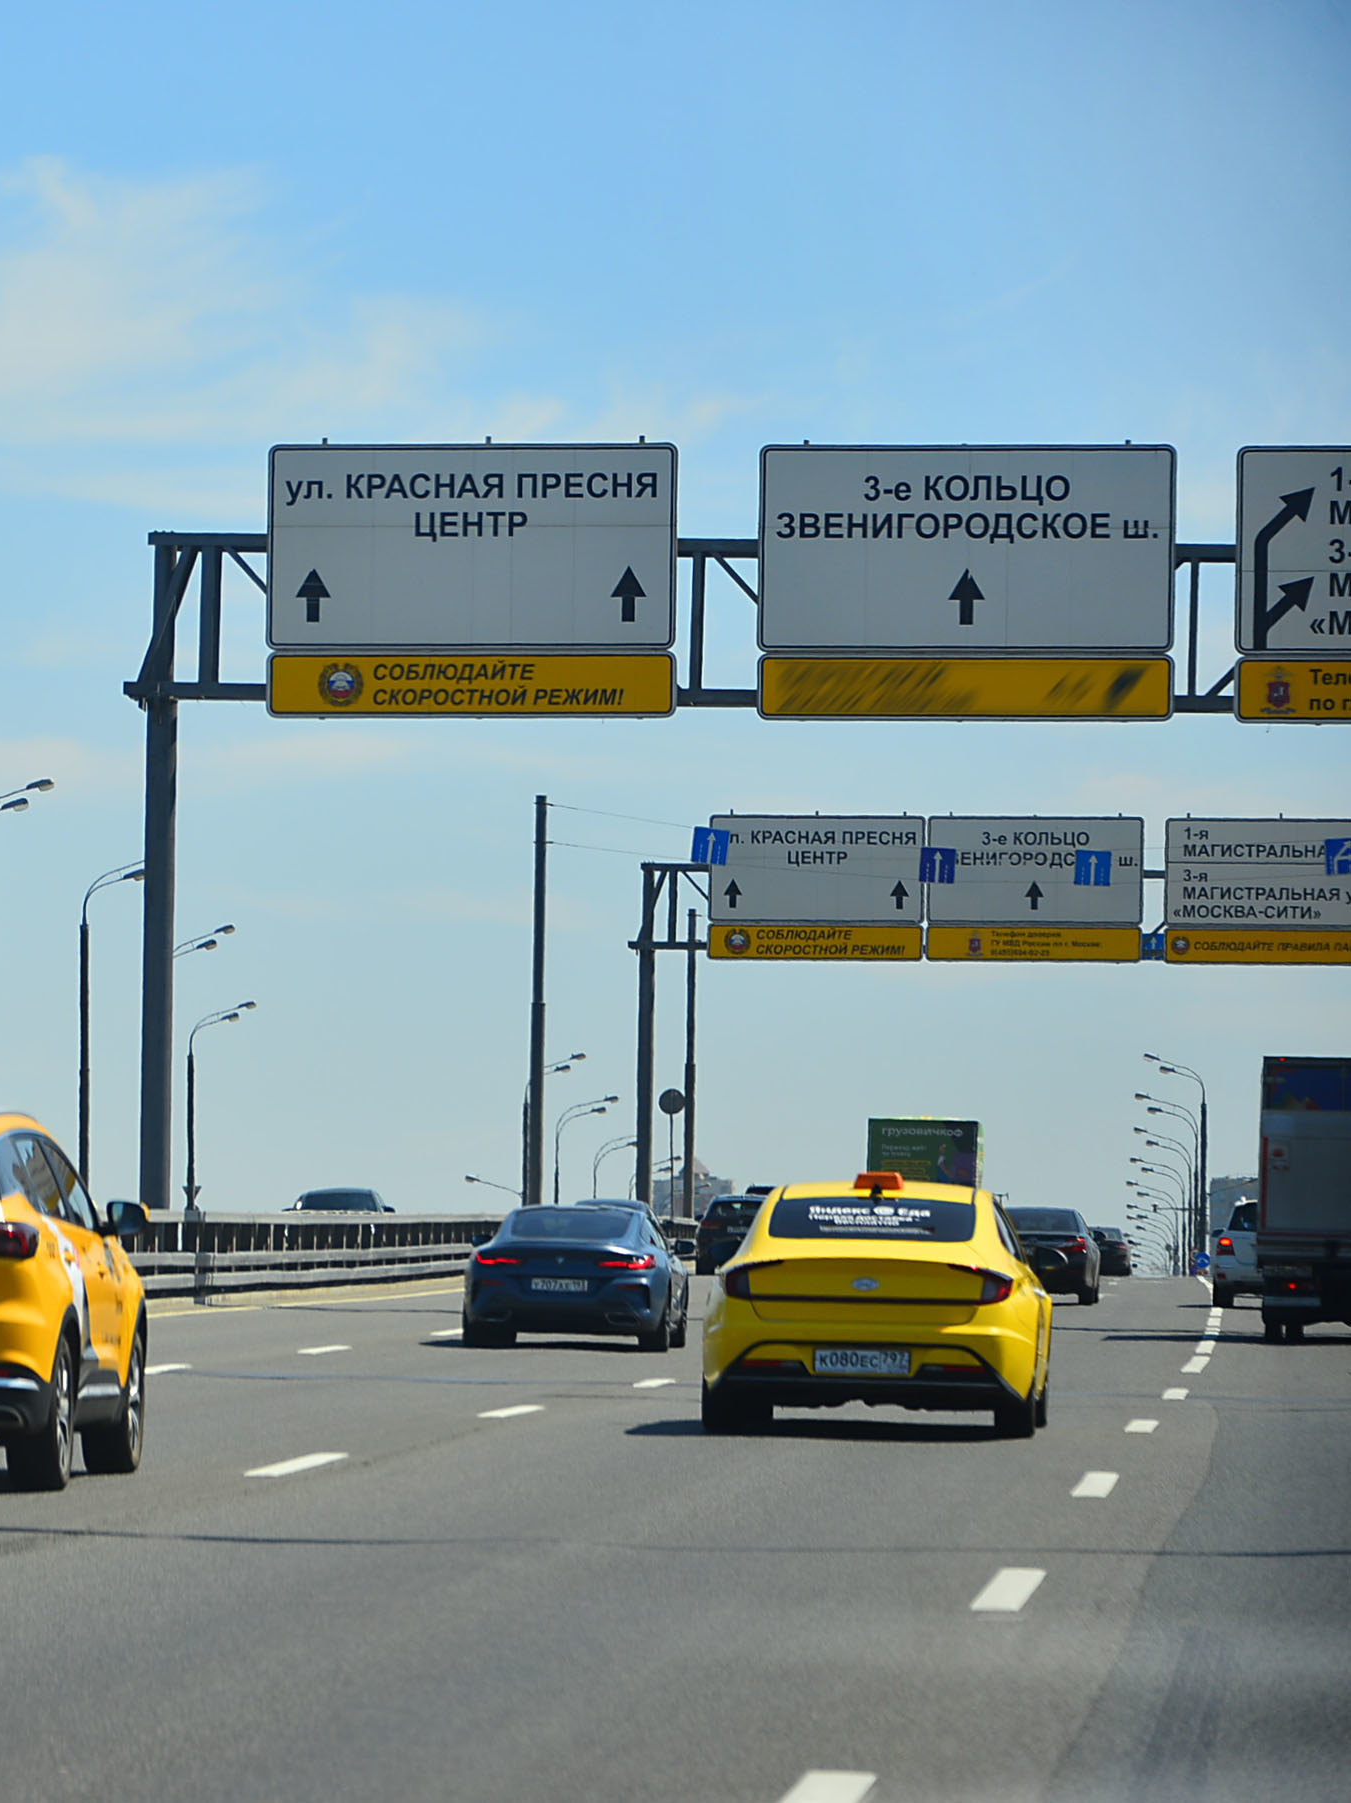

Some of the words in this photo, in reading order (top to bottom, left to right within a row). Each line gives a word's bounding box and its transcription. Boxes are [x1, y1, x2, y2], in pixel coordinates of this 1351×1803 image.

[285, 479, 333, 506] ул.
[345, 473, 504, 500] КРАСНАЯ
[516, 472, 658, 499] ПРЕСНЯ
[863, 475, 912, 502] 3-е
[923, 475, 1071, 506] КОЛЬЦО
[413, 511, 528, 542] ЦЕНТР
[776, 513, 1110, 544] ЗВЕНИГОРОДСКОЕ
[1122, 518, 1160, 540] ш.
[373, 660, 536, 684] СОБЛЮДАЙТЕ
[373, 686, 527, 707] СКОРОСТНОЙ
[533, 688, 625, 707] РЕЖИМ!
[751, 830, 836, 845] КРАСНАЯ
[842, 831, 917, 845] ПРЕСНЯ
[982, 832, 1008, 846] 3-е
[1013, 831, 1090, 848] КОЛЬЦО
[1184, 827, 1209, 840] 1-я
[787, 850, 848, 867] ЦЕНТР
[1183, 844, 1326, 858] МАГИСТРАЛЬНА
[1119, 856, 1138, 867] ш.
[1183, 869, 1208, 882] 3-я
[1182, 886, 1340, 901] МАГИСТРАЛЬНАЯ
[1173, 905, 1321, 919] «МОСКВА-СИТИ»
[756, 928, 853, 941] СОБЛЮДАЙТЕ
[756, 943, 849, 956] СКОРОСТНОЙ
[850, 945, 906, 957] РЕЖИМ!
[1194, 941, 1274, 951] СОБЛЮДАЙТЕ
[1277, 941, 1330, 951] ПРАВИЛА
